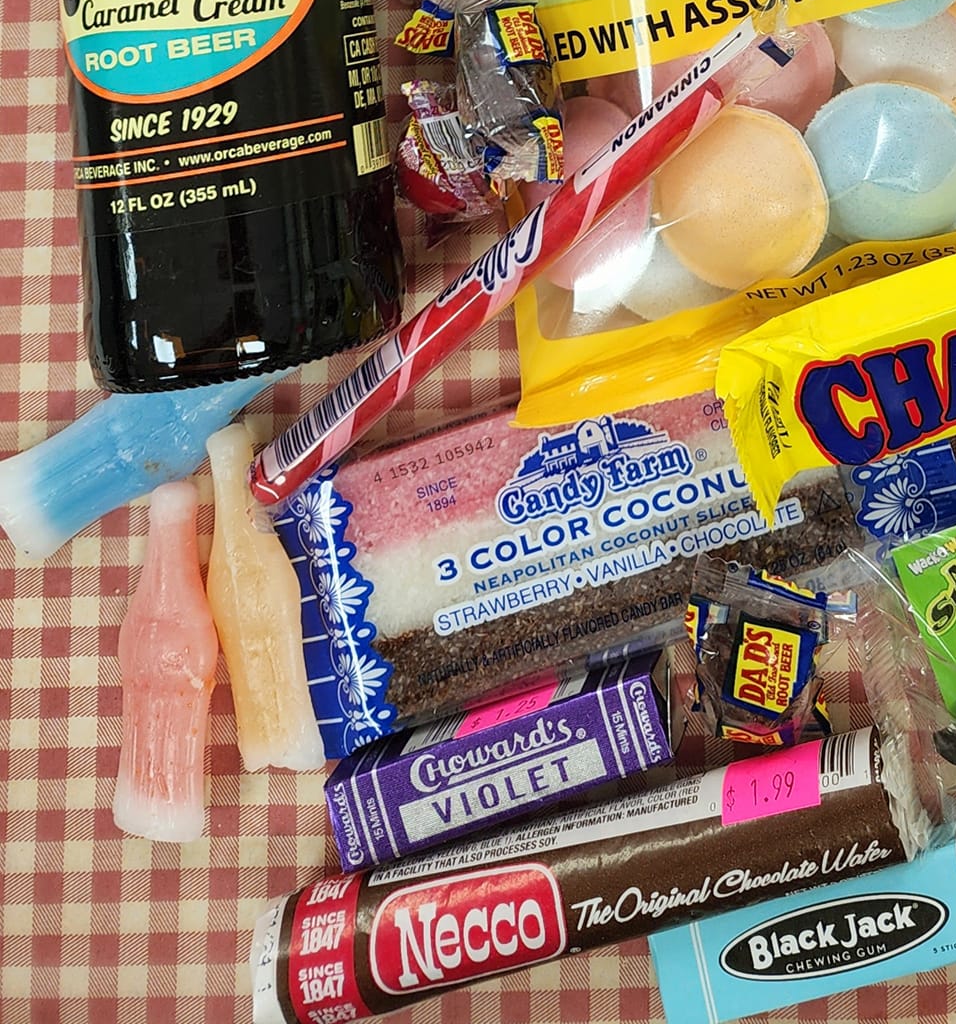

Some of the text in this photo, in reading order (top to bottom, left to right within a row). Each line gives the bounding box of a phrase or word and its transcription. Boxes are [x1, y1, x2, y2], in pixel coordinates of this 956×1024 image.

[85, 28, 257, 73] ROOT BEER
[589, 8, 673, 56] WITH
[110, 101, 239, 143] SINCE 1929
[611, 55, 711, 153] CINNAMON
[178, 129, 332, 168] www.orcabeverage.com
[110, 178, 257, 215] 12 FL OZ (355 mL)
[834, 252, 878, 277] 1.23
[435, 437, 495, 467] 105942
[416, 476, 459, 501] SINCE
[500, 442, 696, 524] Candy Farm
[426, 494, 457, 513] 1894
[437, 472, 749, 581] 3 COLOR COCONU
[437, 501, 800, 633] STRAWBERRY VANILLA CHOCOLTE
[473, 517, 691, 593] NEAPOLITAN COCONUT
[562, 611, 620, 643] FLAVORED
[739, 628, 773, 706] DAD'S
[777, 643, 793, 706] ROOT BEER
[498, 698, 537, 720] 1.25
[432, 756, 570, 824] VIOLET
[750, 771, 796, 807] 1.99
[391, 842, 538, 878] FACILITY PROCESSES
[307, 880, 349, 906] 1847
[571, 899, 616, 930] The
[613, 877, 711, 923] Original
[713, 858, 820, 898] Chocolate
[820, 839, 893, 873] Wafer
[302, 910, 346, 927] SINCE
[748, 902, 919, 971] Black Jack
[299, 924, 343, 956] 1847
[395, 898, 546, 988] Necco
[785, 943, 888, 975] CHEWING GUM
[298, 961, 344, 981] SINCE
[301, 976, 344, 1005] 1847
